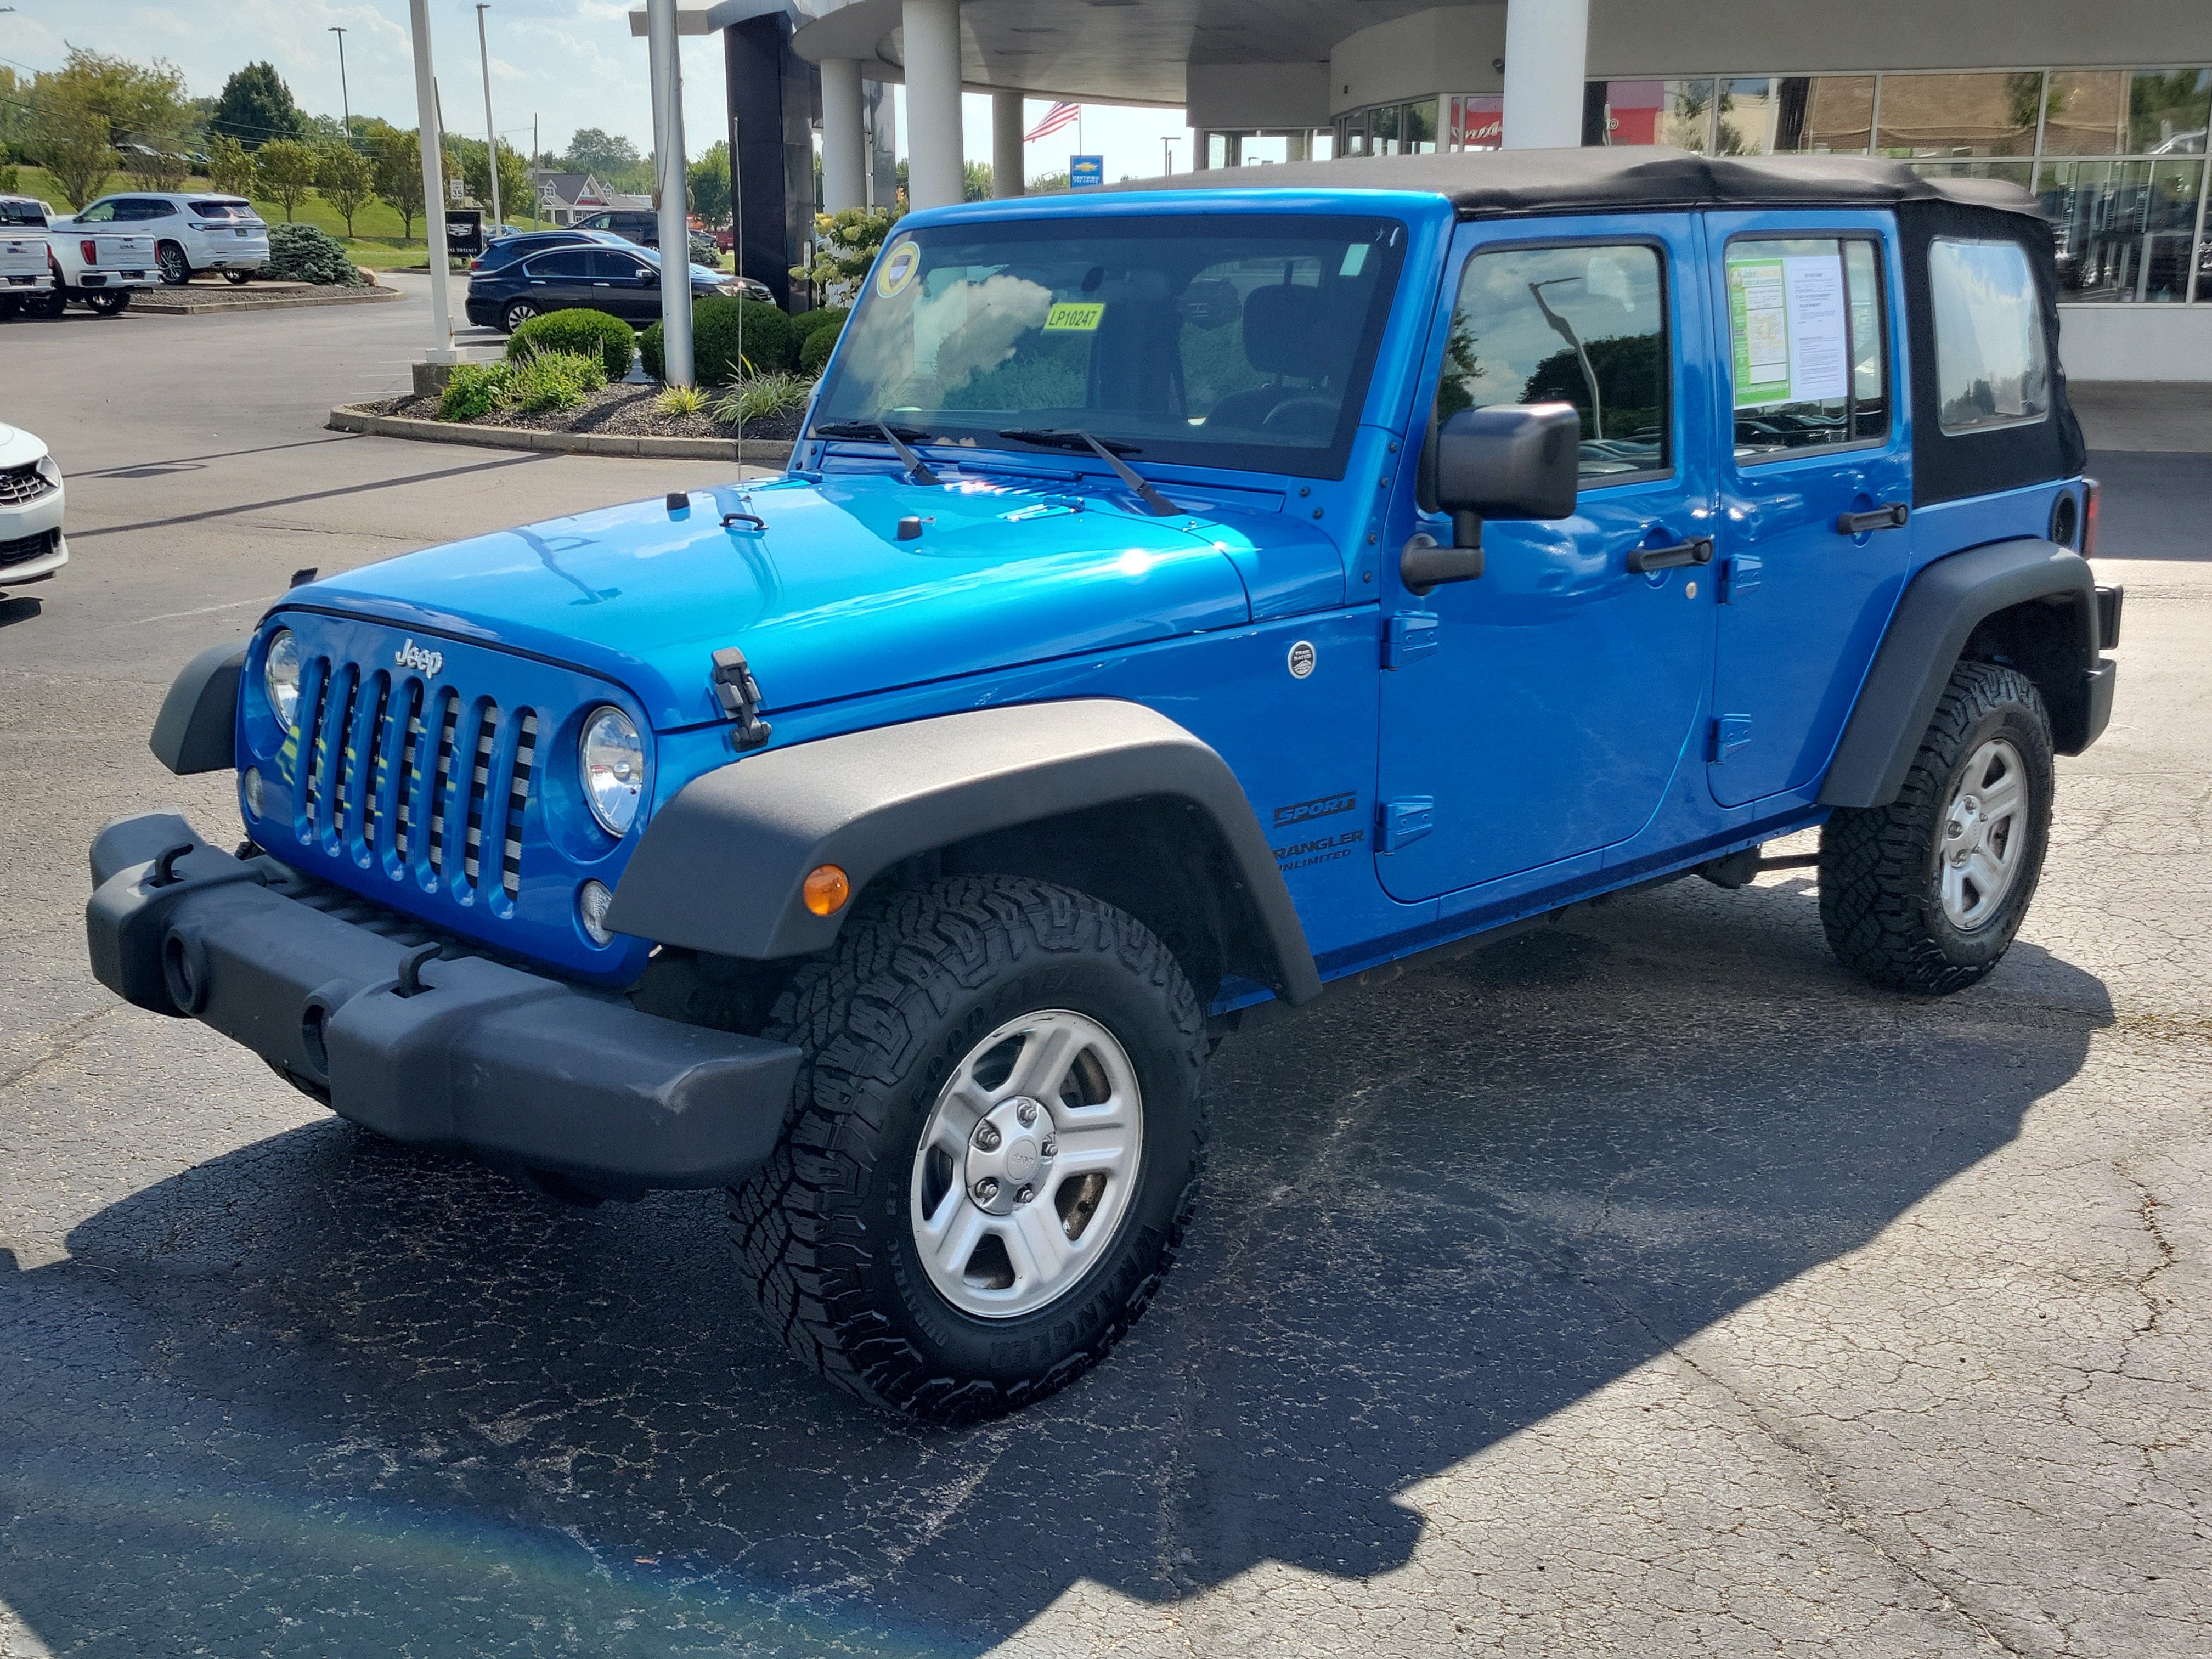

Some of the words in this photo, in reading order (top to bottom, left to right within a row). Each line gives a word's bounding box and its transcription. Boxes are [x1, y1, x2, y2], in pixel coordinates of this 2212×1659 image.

[1048, 311, 1097, 326] LP10247
[395, 638, 443, 679] Jeep
[1278, 794, 1356, 822] SPORT
[1272, 830, 1365, 859] RANGLER
